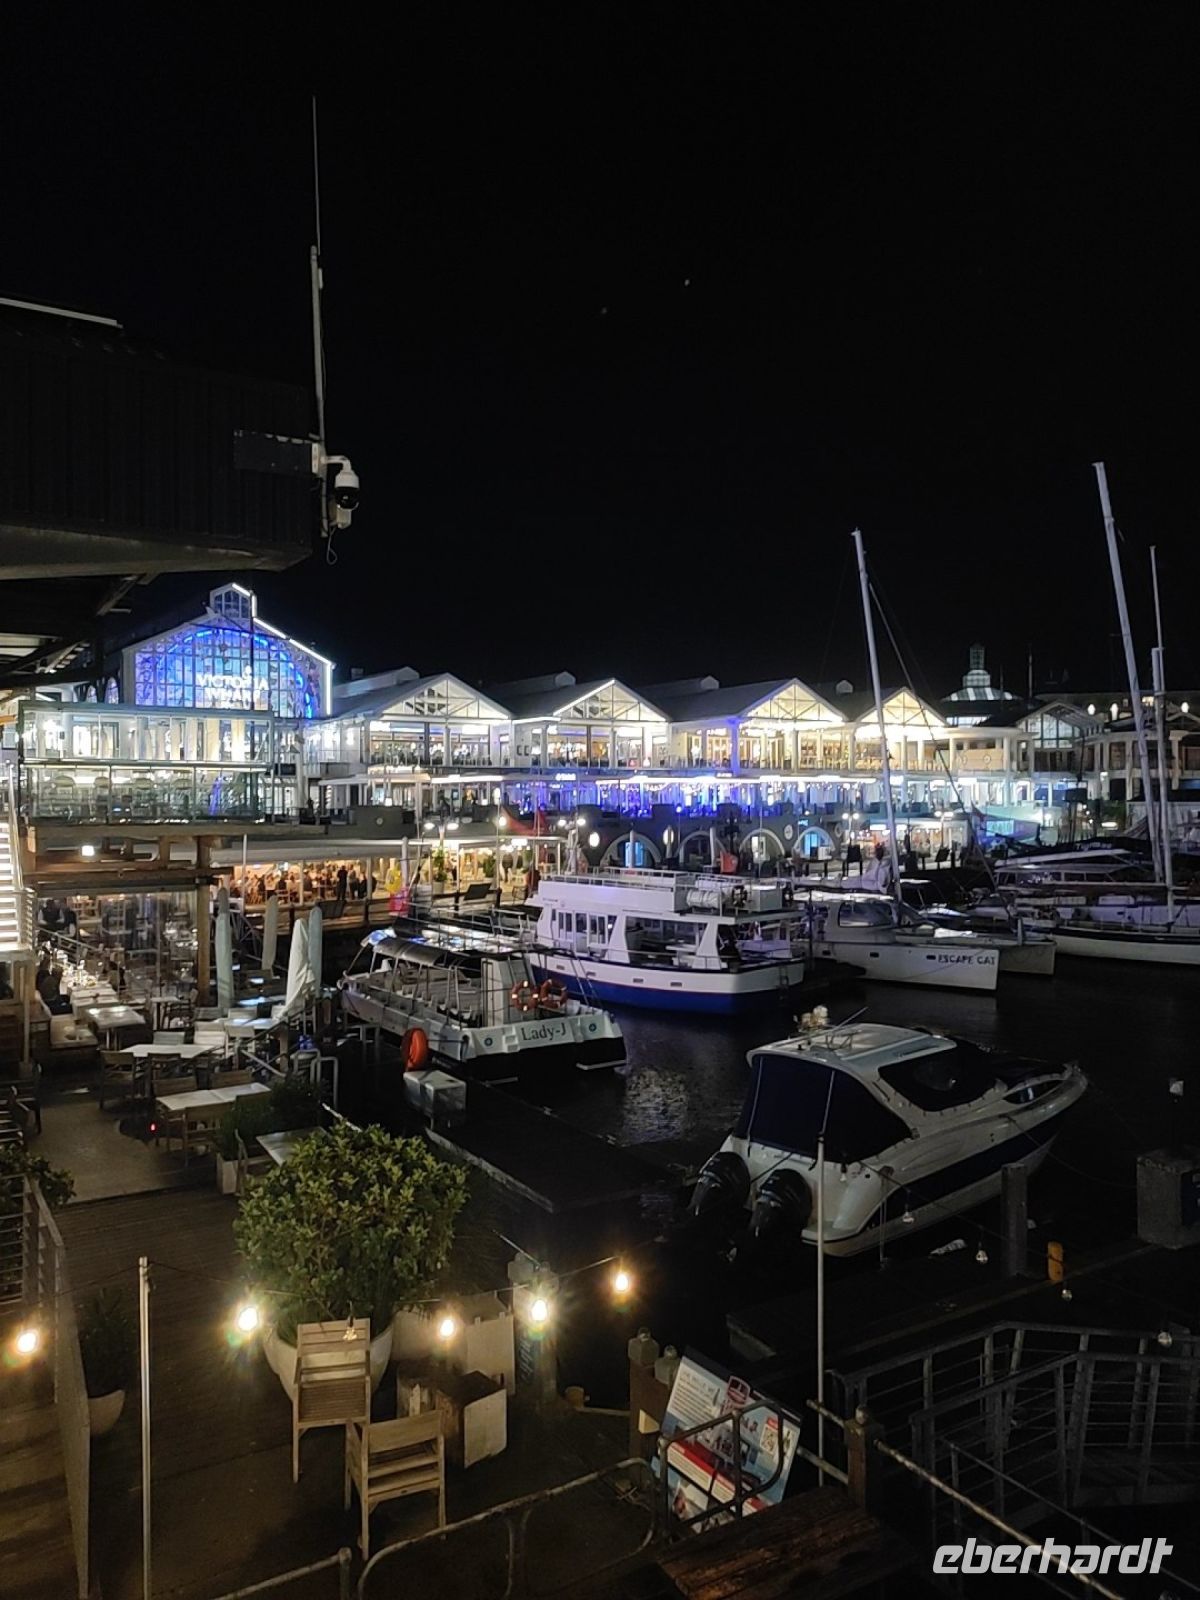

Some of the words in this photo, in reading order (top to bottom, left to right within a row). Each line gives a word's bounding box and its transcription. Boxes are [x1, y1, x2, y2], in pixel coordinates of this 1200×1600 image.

[938, 954, 973, 964] ESCAPE
[977, 956, 996, 965] CAT
[521, 1022, 567, 1041] Lady-J
